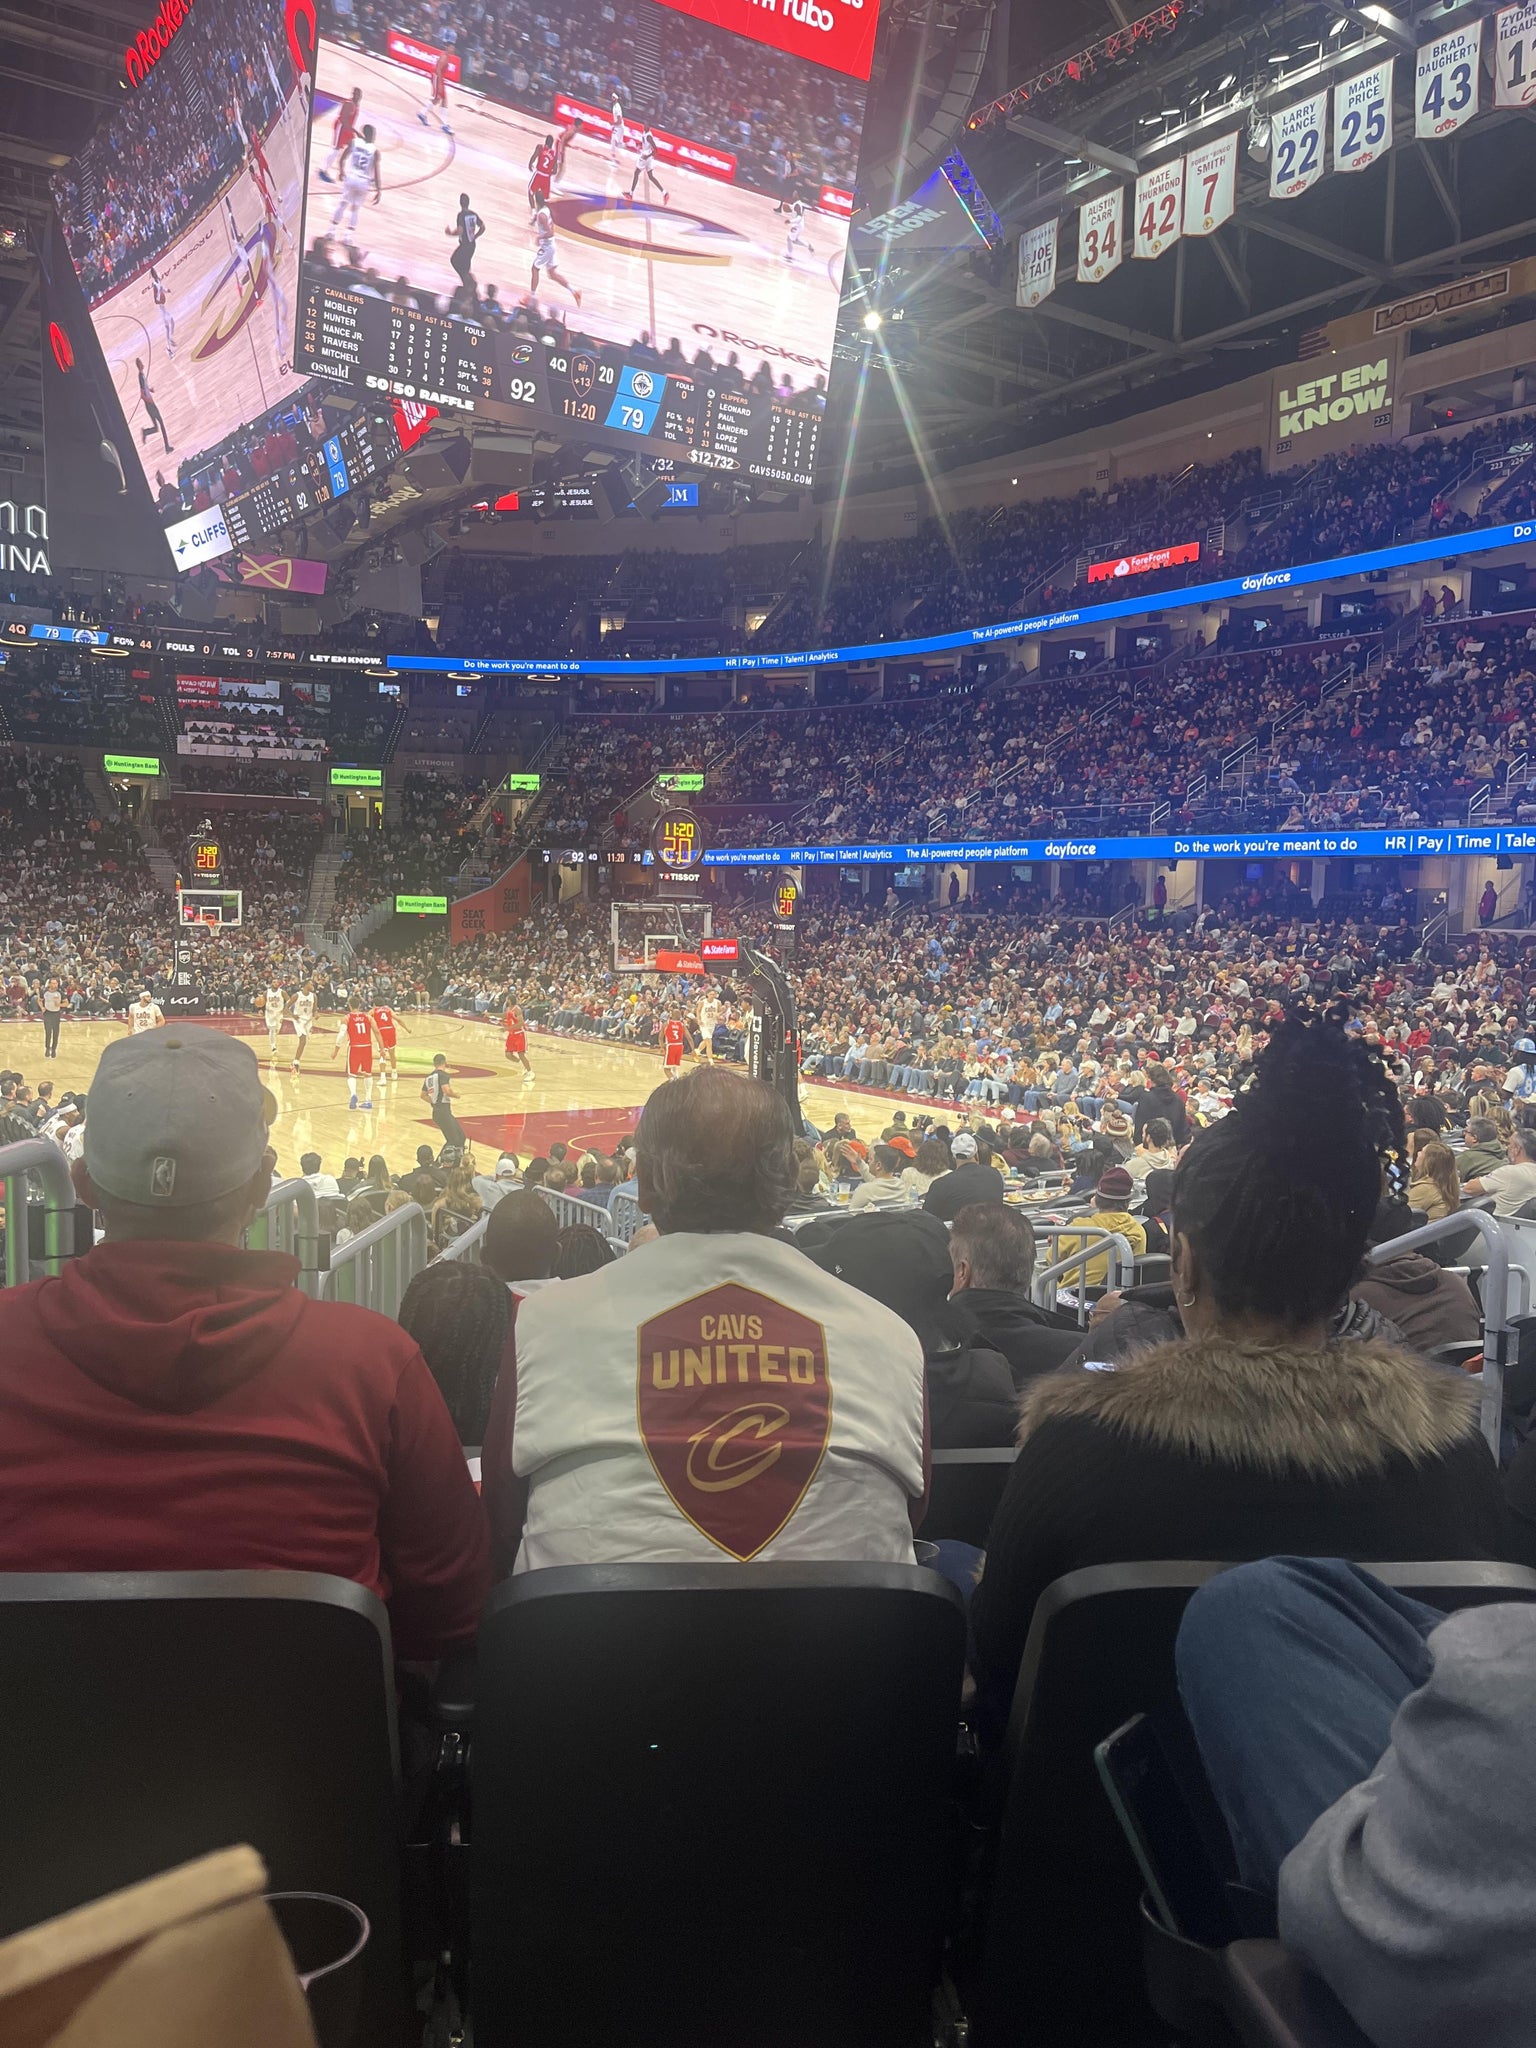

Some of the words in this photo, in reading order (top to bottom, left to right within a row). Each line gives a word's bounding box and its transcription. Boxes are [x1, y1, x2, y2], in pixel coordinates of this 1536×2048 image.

[1432, 35, 1465, 58] BRAD
[1418, 42, 1479, 77] DAUGHERTY
[1348, 72, 1380, 95] MARK
[1422, 62, 1472, 121] 43
[1348, 86, 1380, 108] PRICE
[1283, 102, 1316, 126] LARRY
[1281, 113, 1317, 138] NANCE
[1341, 98, 1386, 158] 25
[1197, 155, 1226, 176] SMITH
[1276, 129, 1319, 185] 22
[1149, 169, 1171, 186] NATE
[1138, 176, 1181, 204] THURMOND
[1203, 172, 1219, 216] 7
[1088, 196, 1116, 218] AUSTIN
[1090, 208, 1113, 226] CARR
[1139, 193, 1176, 242] 42
[1031, 242, 1052, 263] JOE
[1083, 220, 1117, 269] 34
[1029, 257, 1052, 278] TAIT
[324, 288, 364, 304] CAVALIERS
[324, 299, 358, 315] MOBLEY
[323, 311, 356, 327] HUNTER
[323, 323, 350, 338] NANCE
[464, 326, 486, 338] FOULS
[322, 335, 359, 351] TRAVERS
[321, 347, 360, 364] MITCHELL
[311, 362, 350, 379] oswald
[549, 357, 567, 373] 4Q
[598, 366, 614, 384] 20
[510, 379, 536, 403] 92
[676, 381, 695, 392] FOULS
[1279, 374, 1337, 412] LET
[1341, 358, 1388, 393] EM
[419, 389, 475, 411] RAFFLE
[563, 399, 597, 421] 11:20
[621, 405, 644, 430] 79
[718, 412, 735, 423] PAUL
[719, 403, 751, 417] LEONARD
[1279, 384, 1393, 439] KNOW.
[715, 432, 738, 444] LOPEZ
[717, 423, 749, 436] SANDERS
[714, 442, 738, 454] BATUM
[690, 449, 734, 470] $12,732
[749, 464, 812, 485] CAVS5050.COM
[191, 521, 227, 548] CLIFFS
[1513, 526, 1532, 538] Do
[1131, 551, 1170, 567] ForeFront
[1241, 571, 1291, 592] dayforce
[972, 631, 984, 640] The
[1024, 619, 1048, 632] people
[1049, 613, 1079, 628] platform
[8, 623, 27, 635] 4Q
[45, 627, 60, 638] 79
[113, 636, 135, 647] FG%
[139, 640, 152, 649] 44
[166, 642, 196, 652] FOULS
[222, 647, 240, 656] TOL
[265, 650, 282, 659] 7:57
[283, 652, 296, 660] PM
[309, 654, 331, 663] LET
[331, 655, 347, 663] EM
[347, 656, 383, 665] KNOW.
[463, 660, 476, 668] Do
[491, 661, 510, 669] work
[511, 662, 535, 670] you're
[569, 662, 580, 670] do
[725, 658, 737, 666] HR
[742, 659, 756, 667] Pay
[761, 657, 779, 665] Time
[784, 655, 804, 664] Talent
[808, 652, 839, 661] Analytics
[664, 822, 695, 837] 11:20
[663, 836, 692, 863] 20
[906, 848, 919, 858] The
[965, 846, 992, 859] people
[994, 845, 1028, 858] platform
[1044, 842, 1096, 859] dayforce
[1174, 841, 1190, 853] Do
[1192, 840, 1210, 852] the
[1213, 840, 1241, 852] work
[1244, 839, 1280, 855] you're
[1283, 838, 1320, 851] meant
[1324, 838, 1337, 851] to
[1340, 837, 1357, 850] do
[1385, 836, 1407, 849] HR
[1417, 835, 1443, 852] Pay
[1455, 834, 1492, 848] Time
[197, 854, 216, 868] 20
[571, 852, 584, 862] 92
[607, 853, 625, 862] 11:20
[705, 853, 715, 862] the
[716, 853, 730, 861] work
[772, 853, 781, 861] do
[790, 852, 800, 860] HR
[804, 852, 816, 862] Pay
[820, 851, 835, 859] Time
[839, 851, 858, 859] Talent
[863, 850, 893, 860] Analytics
[670, 873, 700, 882] TISSOT
[462, 909, 485, 919] SEAT
[778, 900, 793, 915] 20
[461, 919, 486, 929] GEEK
[355, 1023, 366, 1034] 11
[672, 1030, 679, 1040] 3
[700, 1314, 763, 1341] CAVS
[652, 1344, 816, 1390] UNITED
